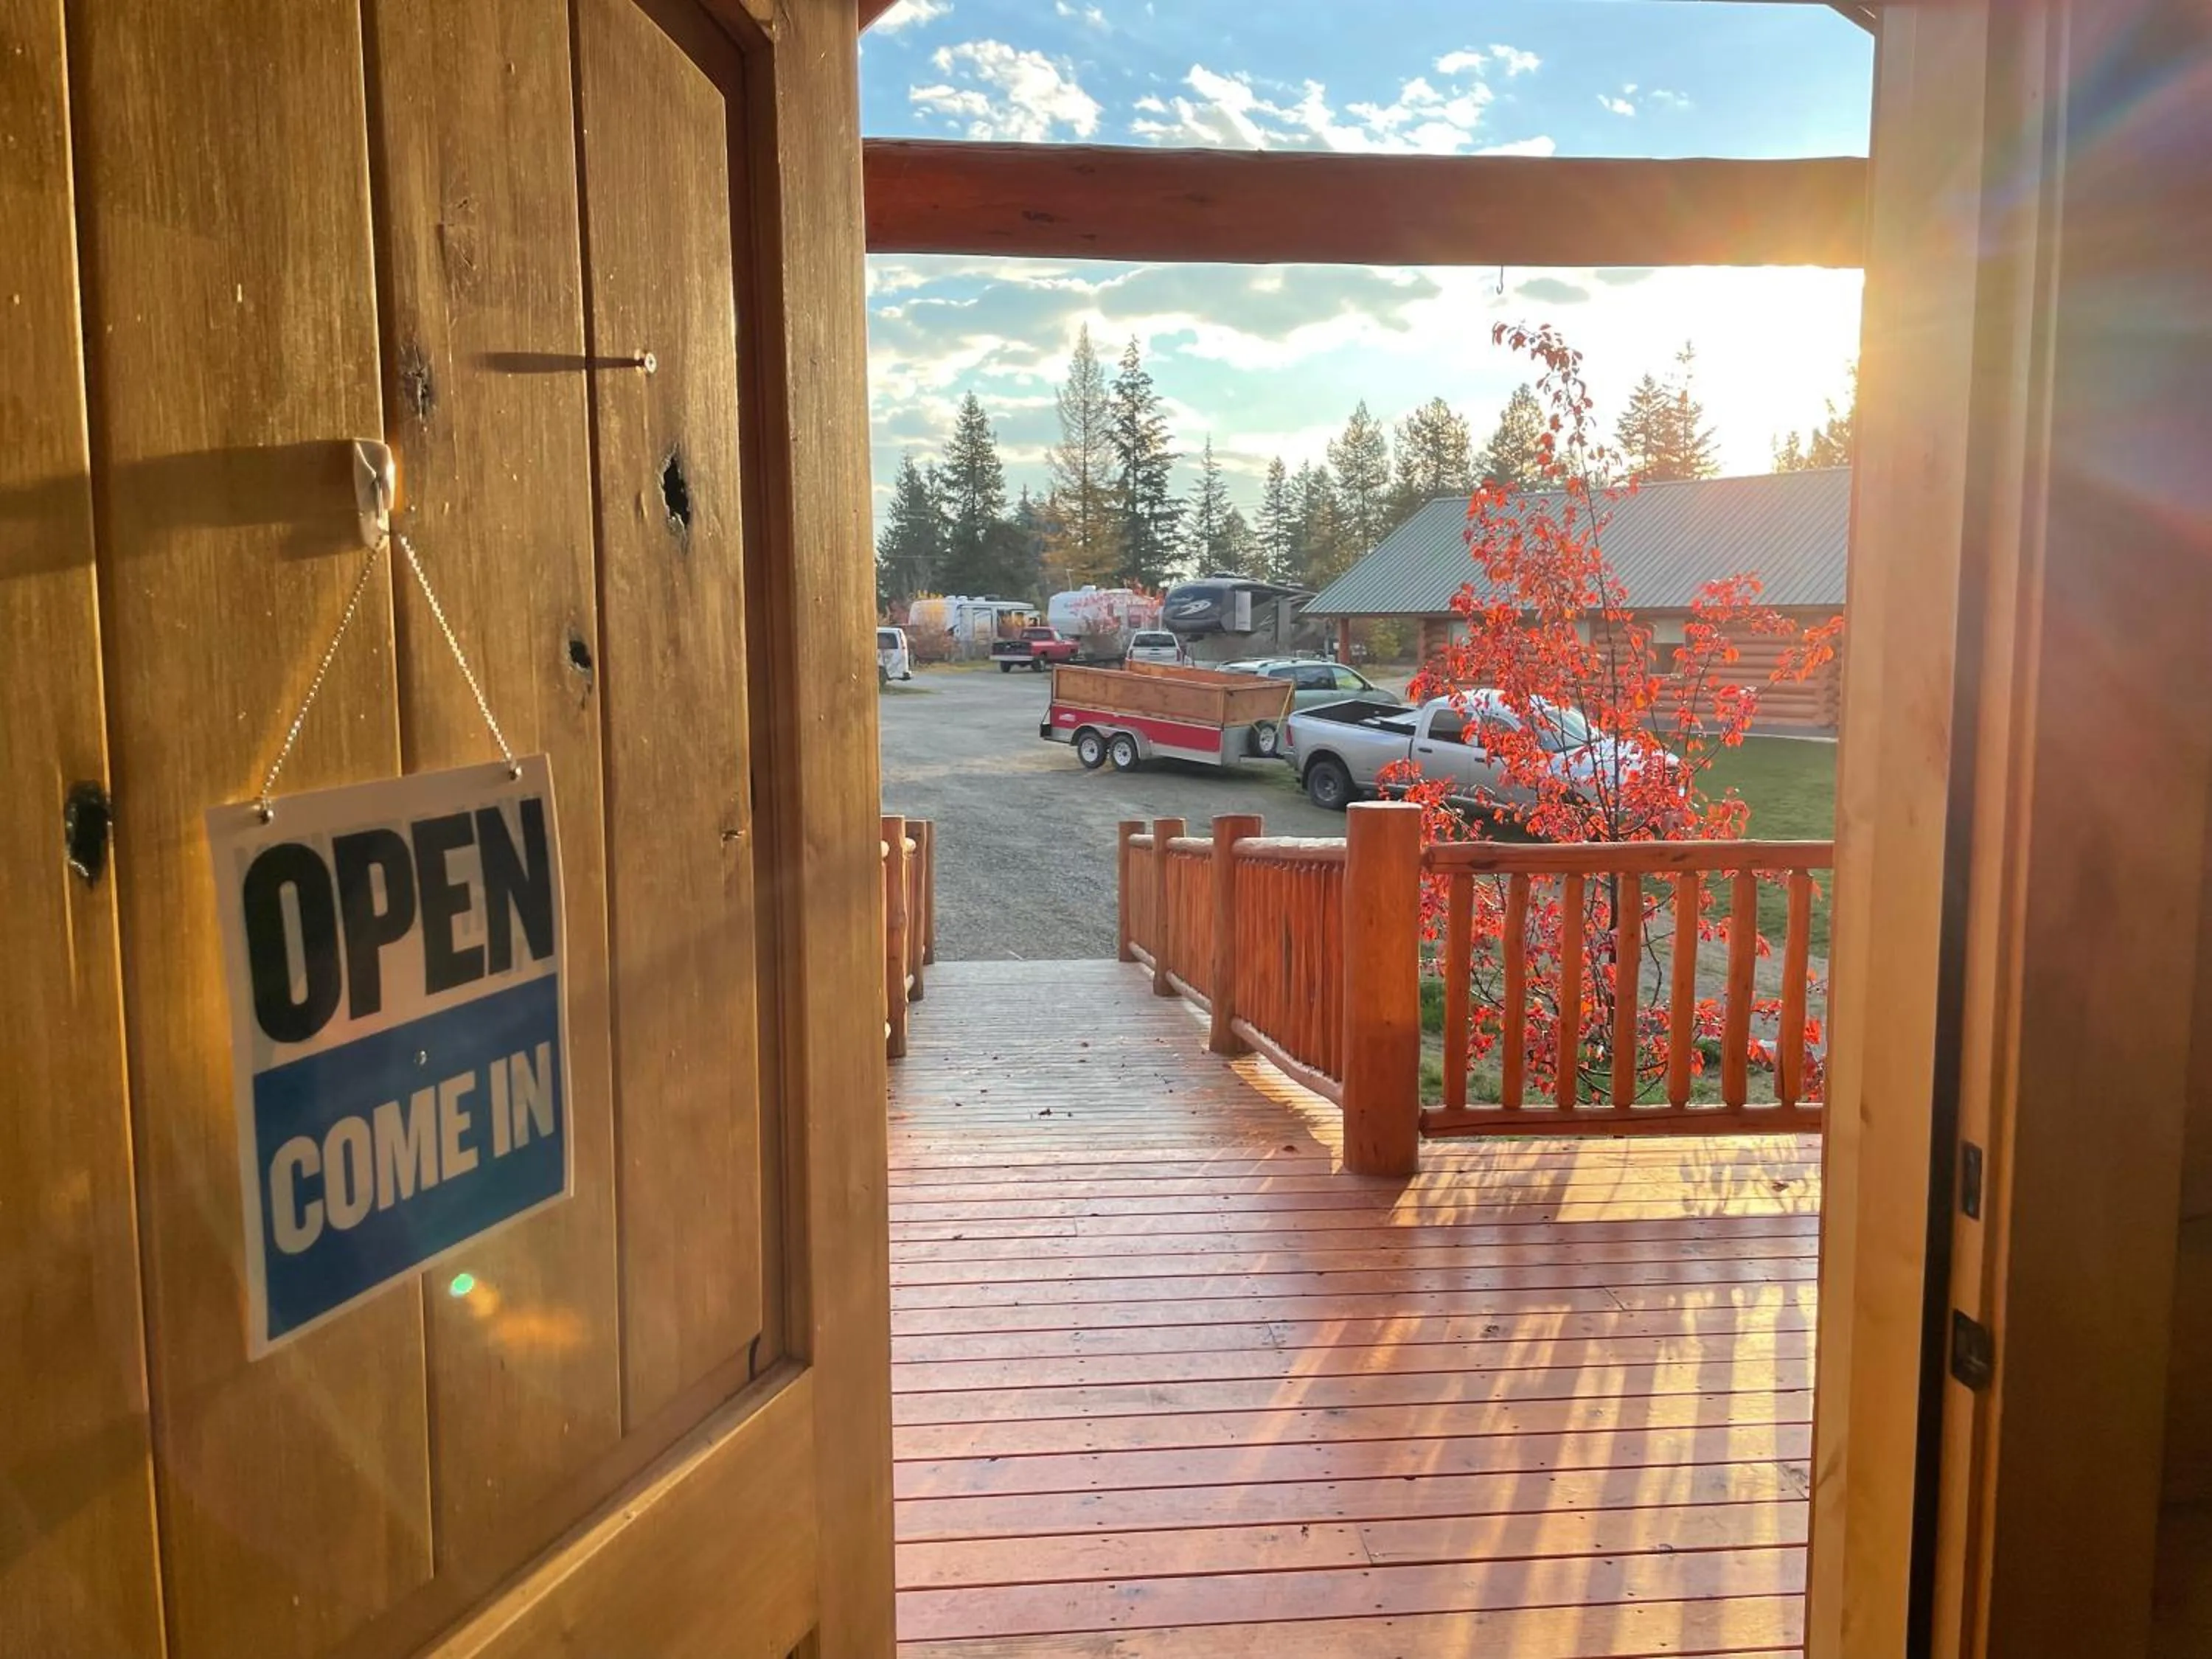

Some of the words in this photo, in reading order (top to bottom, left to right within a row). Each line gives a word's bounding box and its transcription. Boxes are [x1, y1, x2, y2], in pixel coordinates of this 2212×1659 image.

[243, 798, 554, 1043] OPEN
[269, 1071, 479, 1256] COME
[490, 1041, 555, 1158] IN
